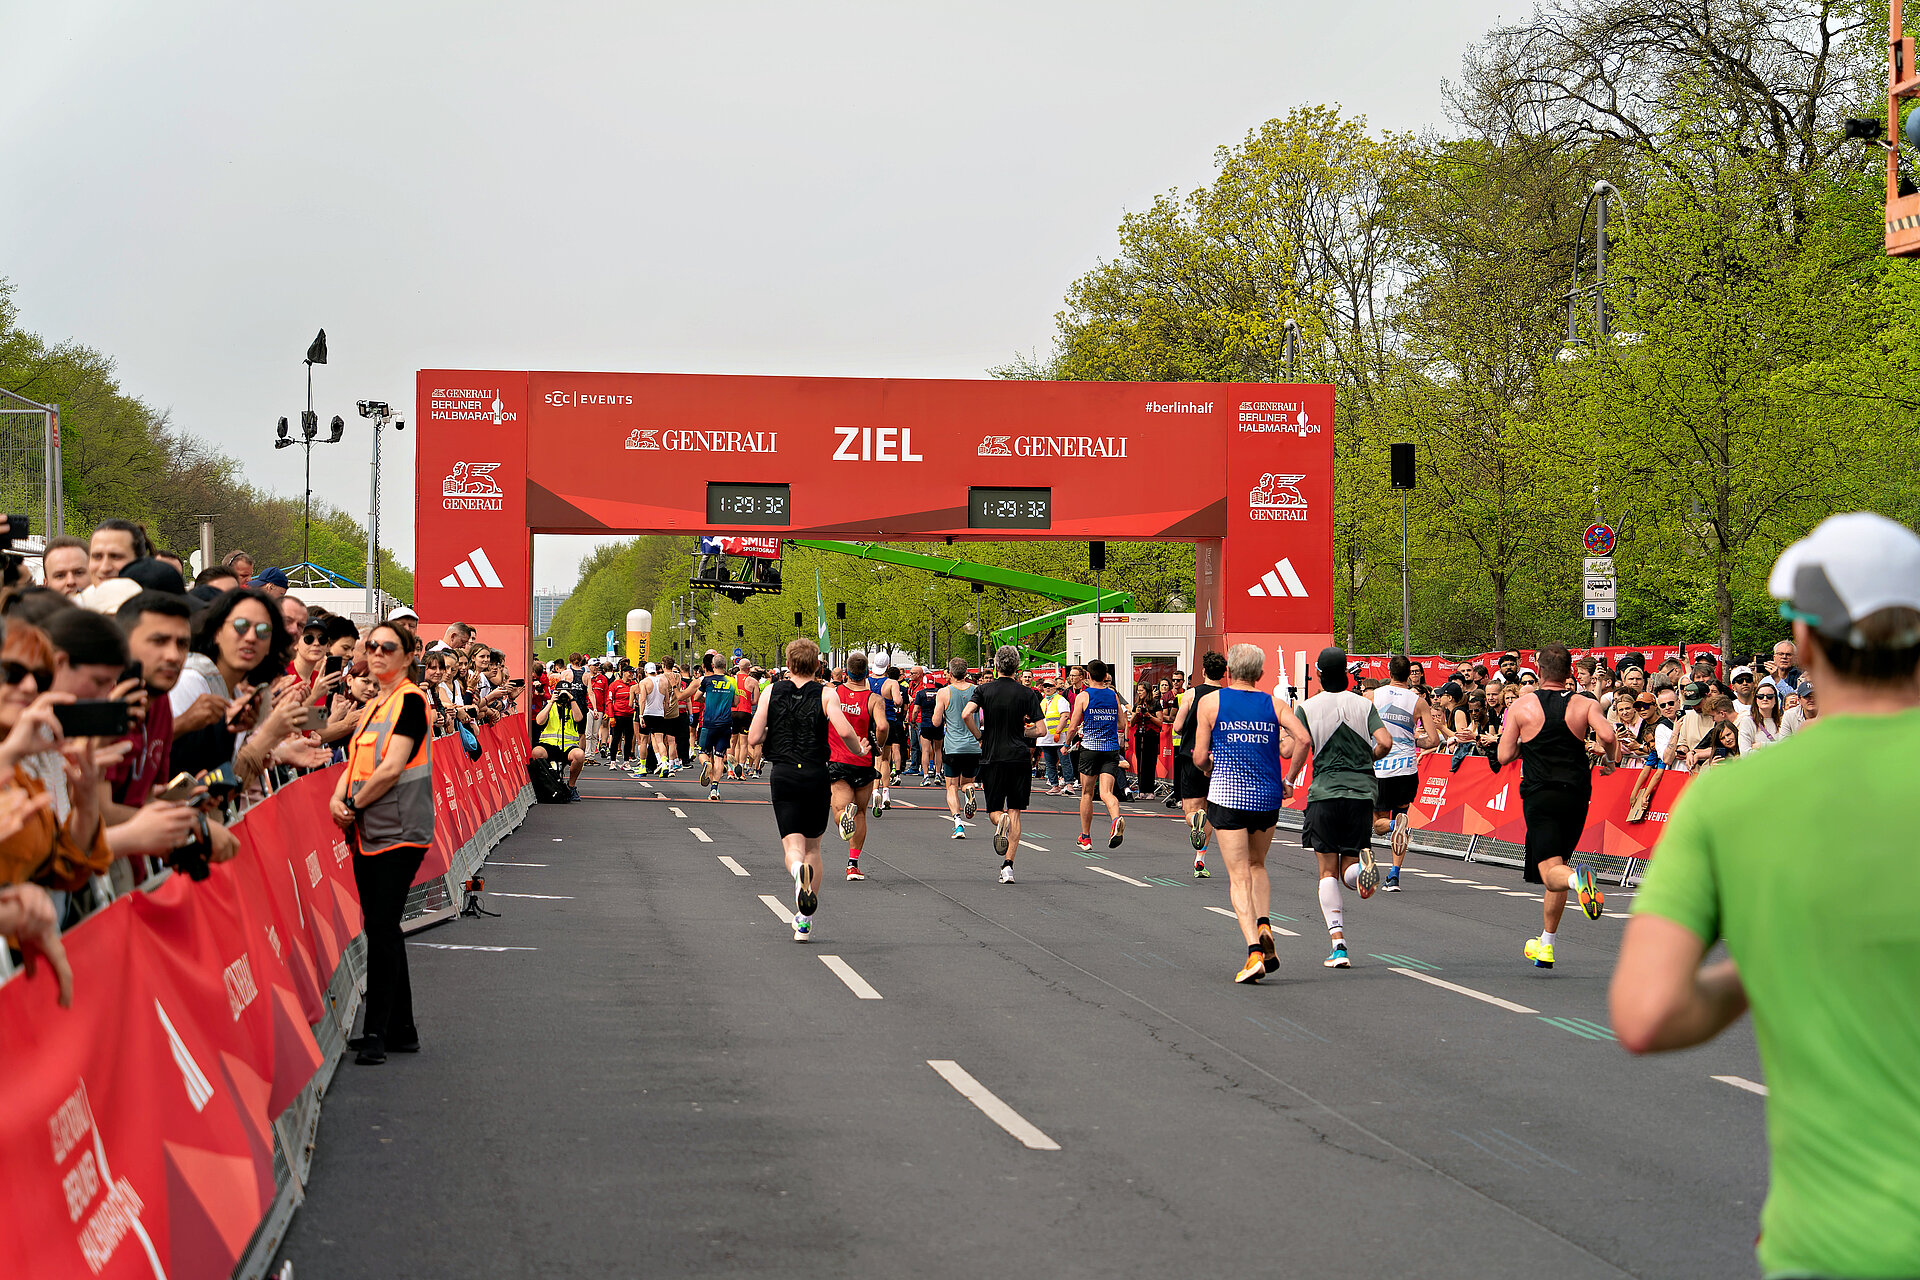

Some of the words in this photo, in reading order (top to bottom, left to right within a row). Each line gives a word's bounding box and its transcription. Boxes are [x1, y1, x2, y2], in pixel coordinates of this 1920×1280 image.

[446, 388, 492, 399] GENERALI
[544, 391, 571, 407] SCC
[580, 395, 633, 405] EVENTS
[431, 401, 482, 411] BERLINER
[1145, 401, 1214, 414] #berlinhalf
[1252, 401, 1298, 412] GENERALI
[431, 411, 517, 422] HALBMARATHON
[1238, 413, 1288, 423] BERLINER
[1238, 423, 1321, 434] HALBMARATHON
[662, 429, 778, 453] GENERALI
[832, 427, 923, 462] ZIEL
[1014, 435, 1128, 458] GENERALI
[442, 498, 503, 511] GENERALI
[720, 496, 784, 514] 1:29:32
[983, 500, 1046, 518] 1:29:32
[1249, 508, 1308, 521] GENERALI
[740, 536, 779, 549] SMILE!
[1220, 721, 1275, 733] DASSAULT
[1227, 733, 1269, 744] SPORTS
[1375, 757, 1414, 771] ELITE
